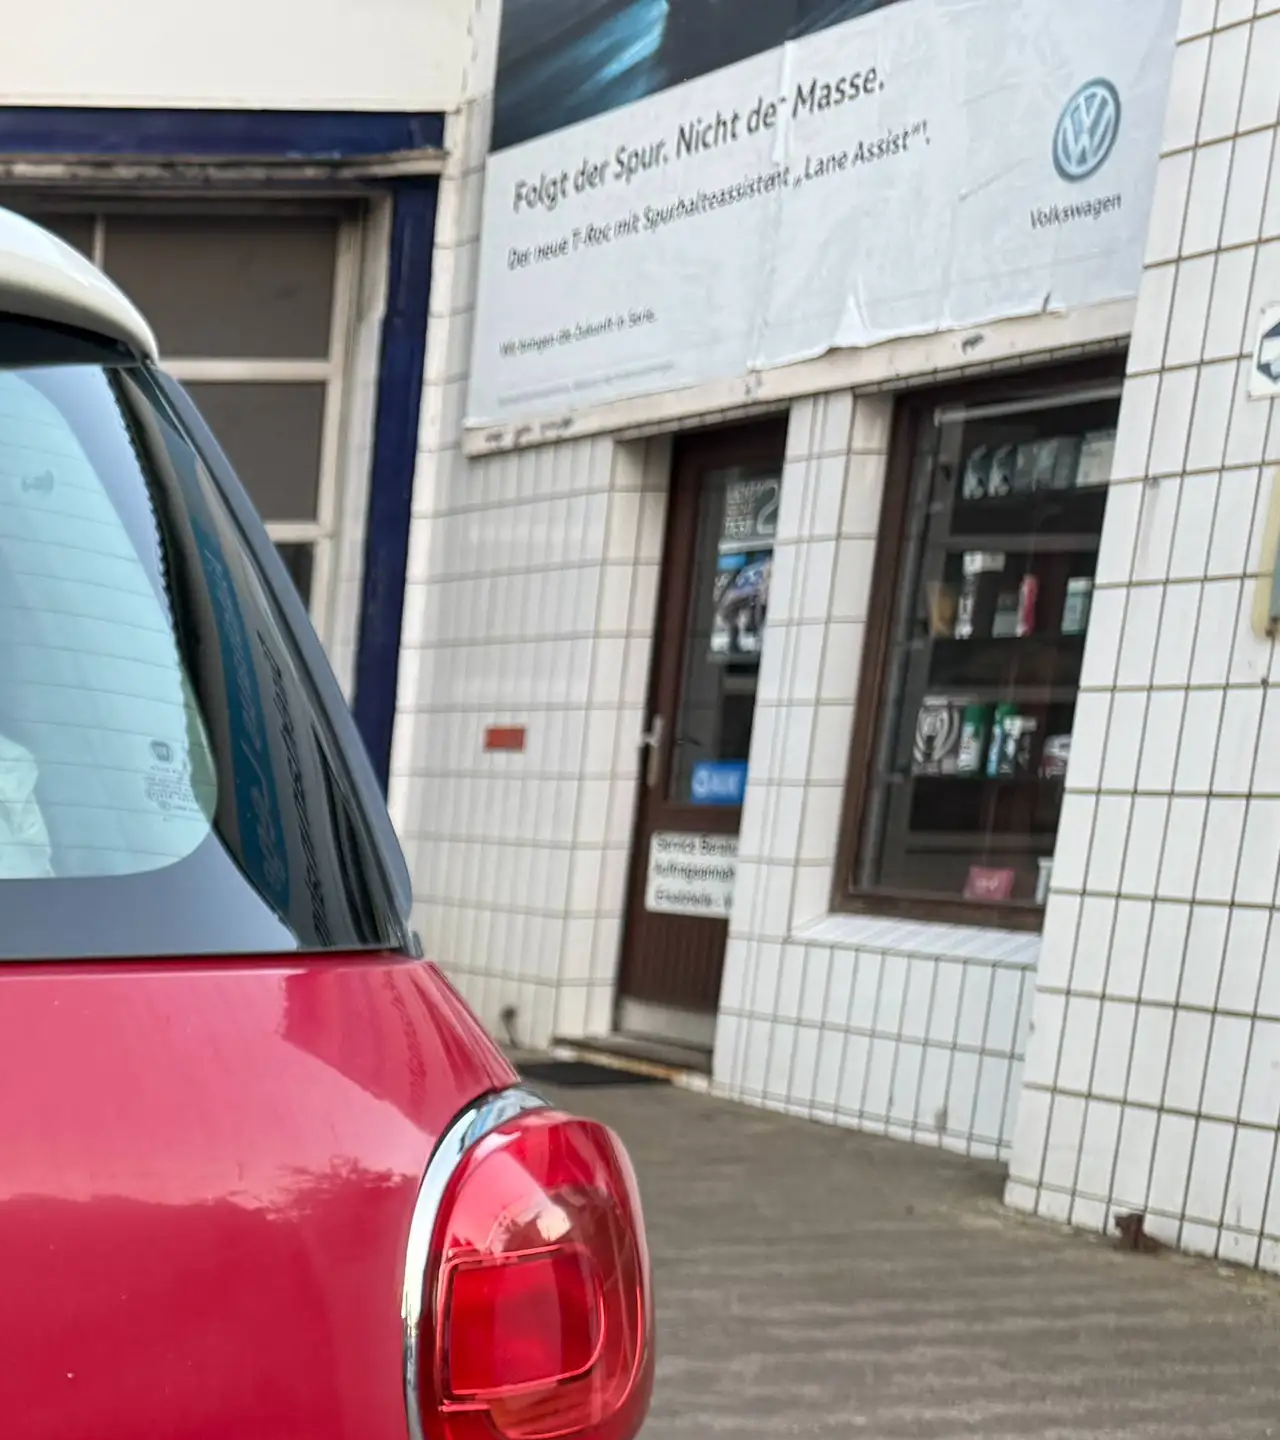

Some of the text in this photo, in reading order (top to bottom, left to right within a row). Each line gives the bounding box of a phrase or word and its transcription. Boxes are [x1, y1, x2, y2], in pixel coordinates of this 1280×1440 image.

[513, 168, 569, 214] Folgt
[573, 155, 610, 195] der
[613, 138, 669, 187] Spur.
[676, 109, 741, 160] Nicht
[792, 66, 885, 120] Masse.
[1030, 192, 1122, 230] Volkswagen
